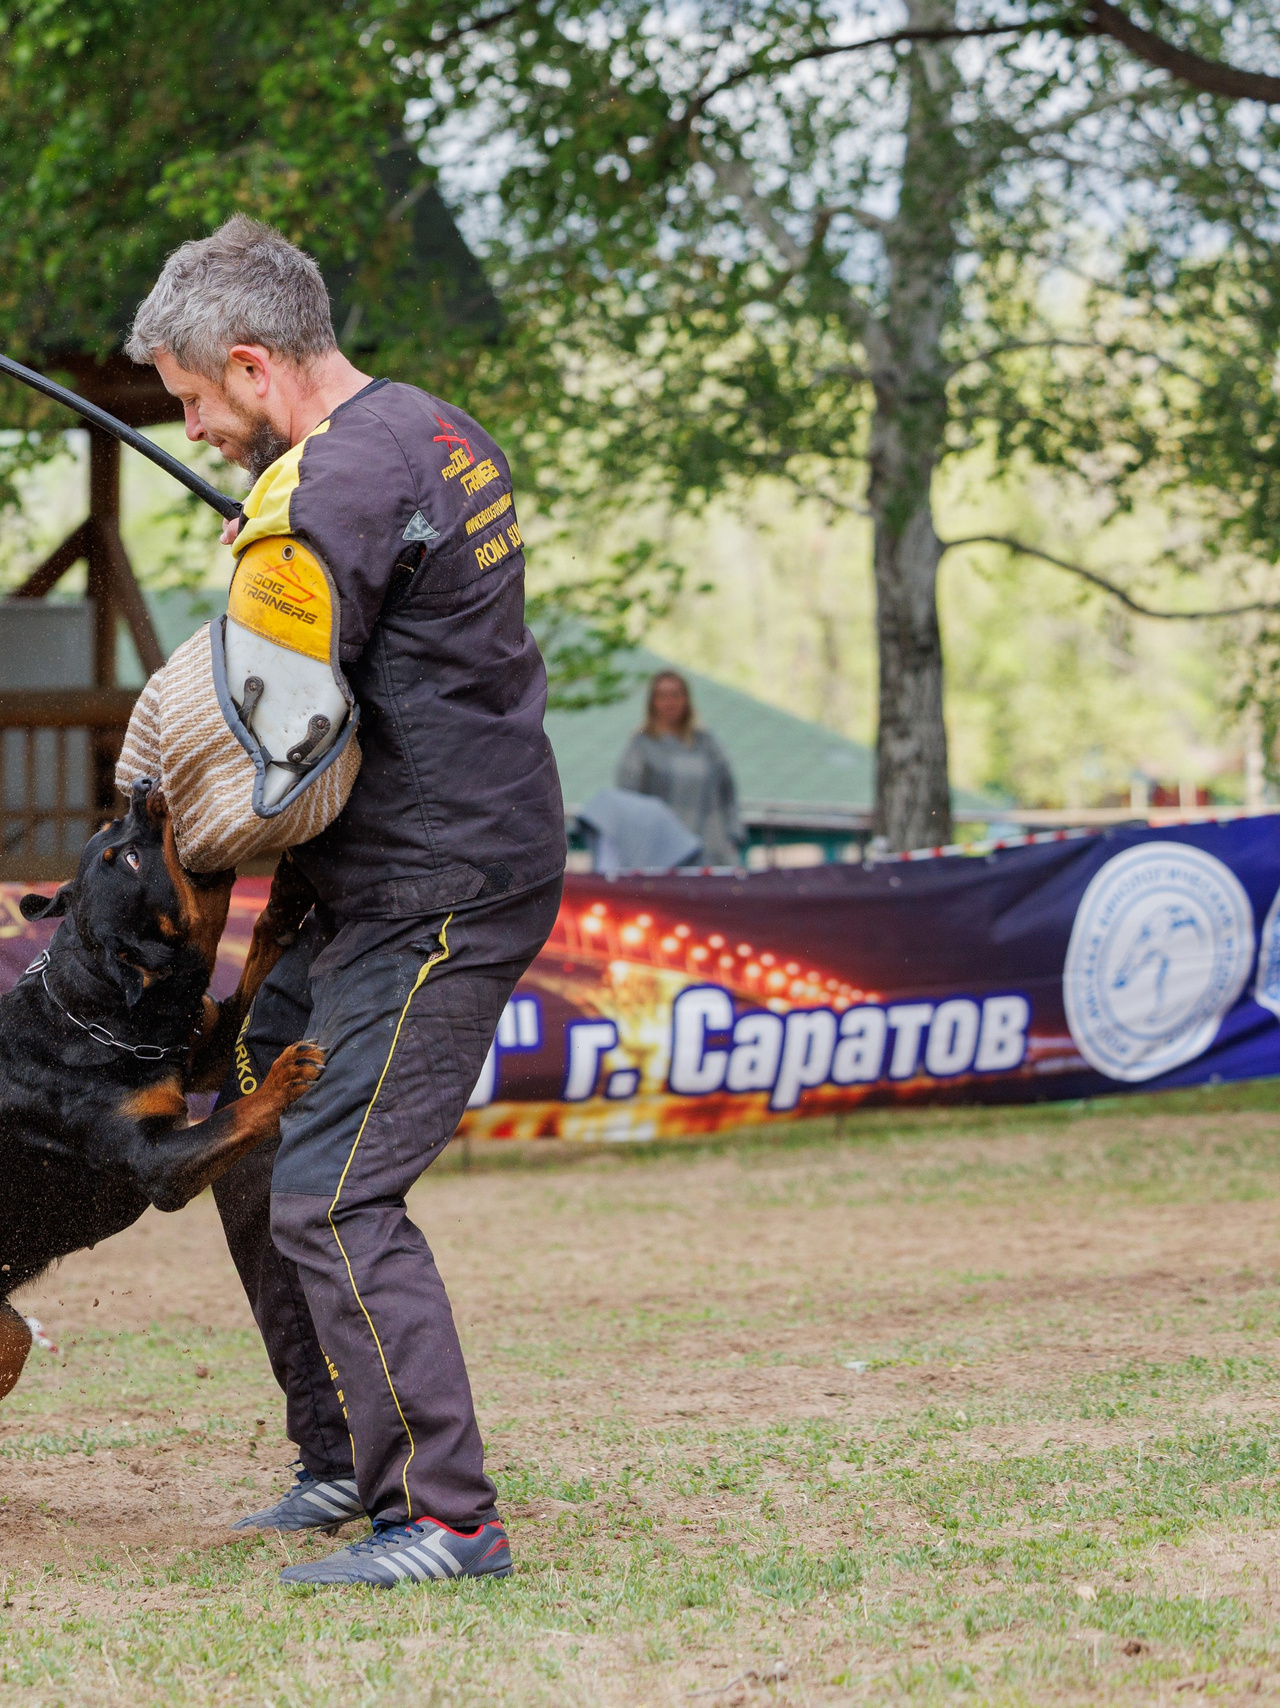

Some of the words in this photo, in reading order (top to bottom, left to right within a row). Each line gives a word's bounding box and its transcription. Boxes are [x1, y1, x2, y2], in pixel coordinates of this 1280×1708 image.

[242, 582, 318, 625] TRAINERS
[253, 572, 285, 595] DOG
[564, 1022, 639, 1100] г.
[669, 987, 1029, 1110] Саратов
